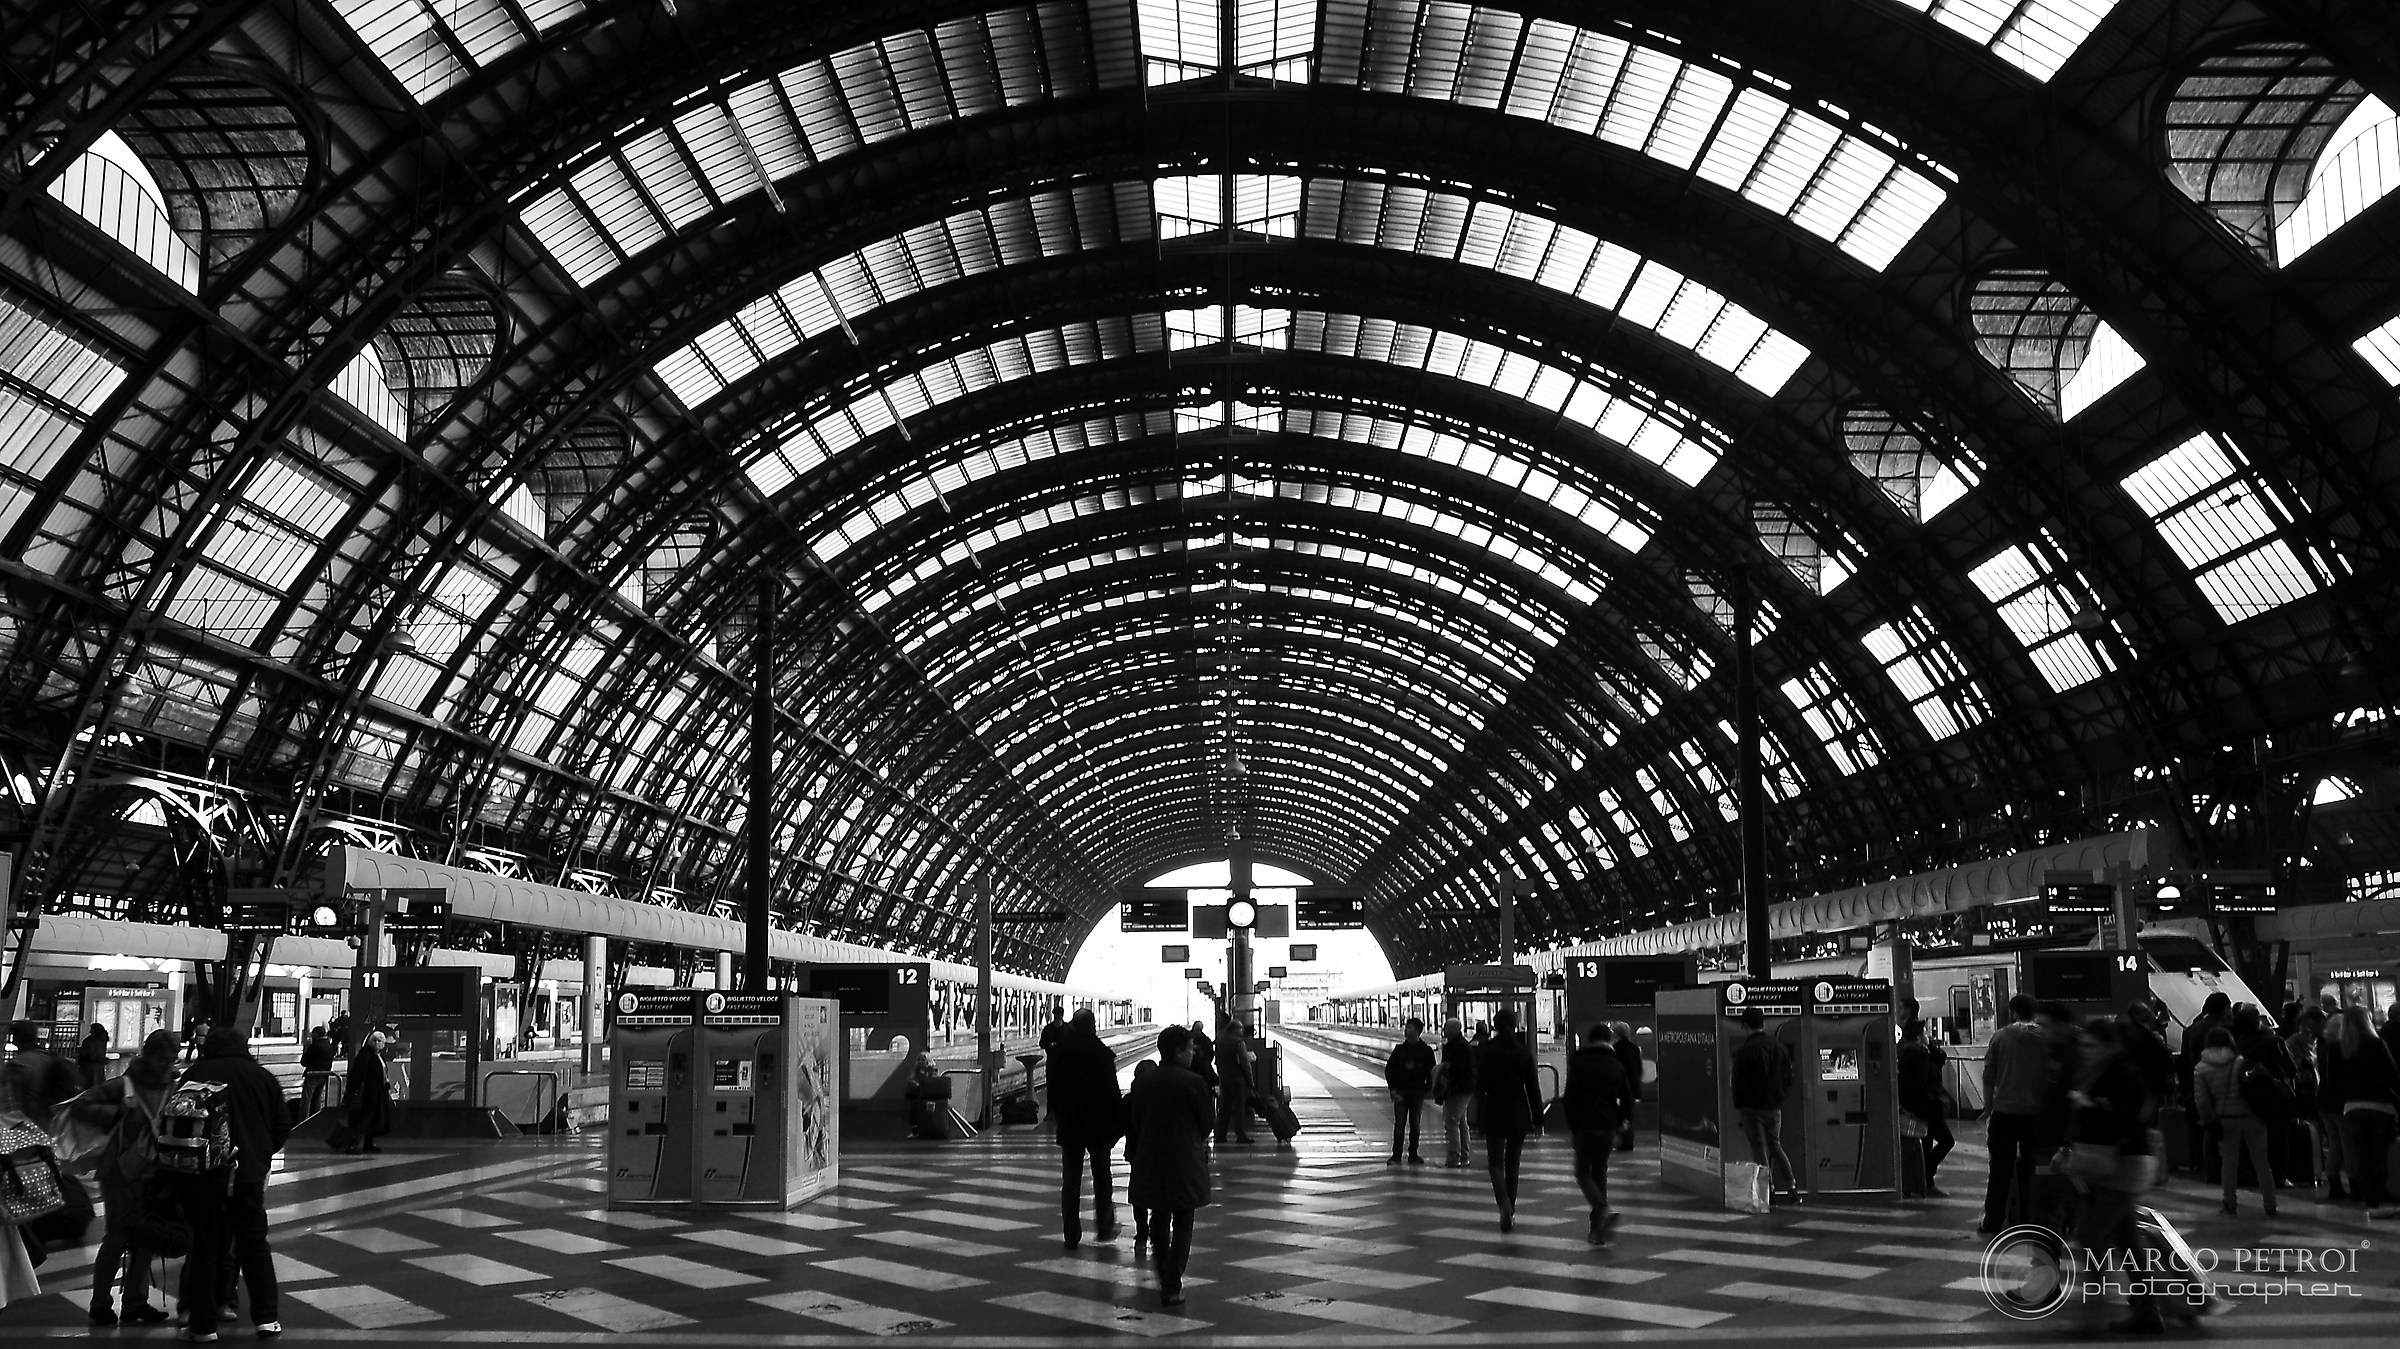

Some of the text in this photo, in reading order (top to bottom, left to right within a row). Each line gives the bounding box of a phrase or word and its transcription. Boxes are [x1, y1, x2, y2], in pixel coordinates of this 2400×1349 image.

[222, 905, 233, 915] 10
[1122, 903, 1133, 913] 12
[1352, 900, 1363, 911] 13
[1576, 961, 1599, 978] 13
[2116, 955, 2138, 972] 14
[362, 972, 381, 988] 11
[896, 968, 918, 985] 12
